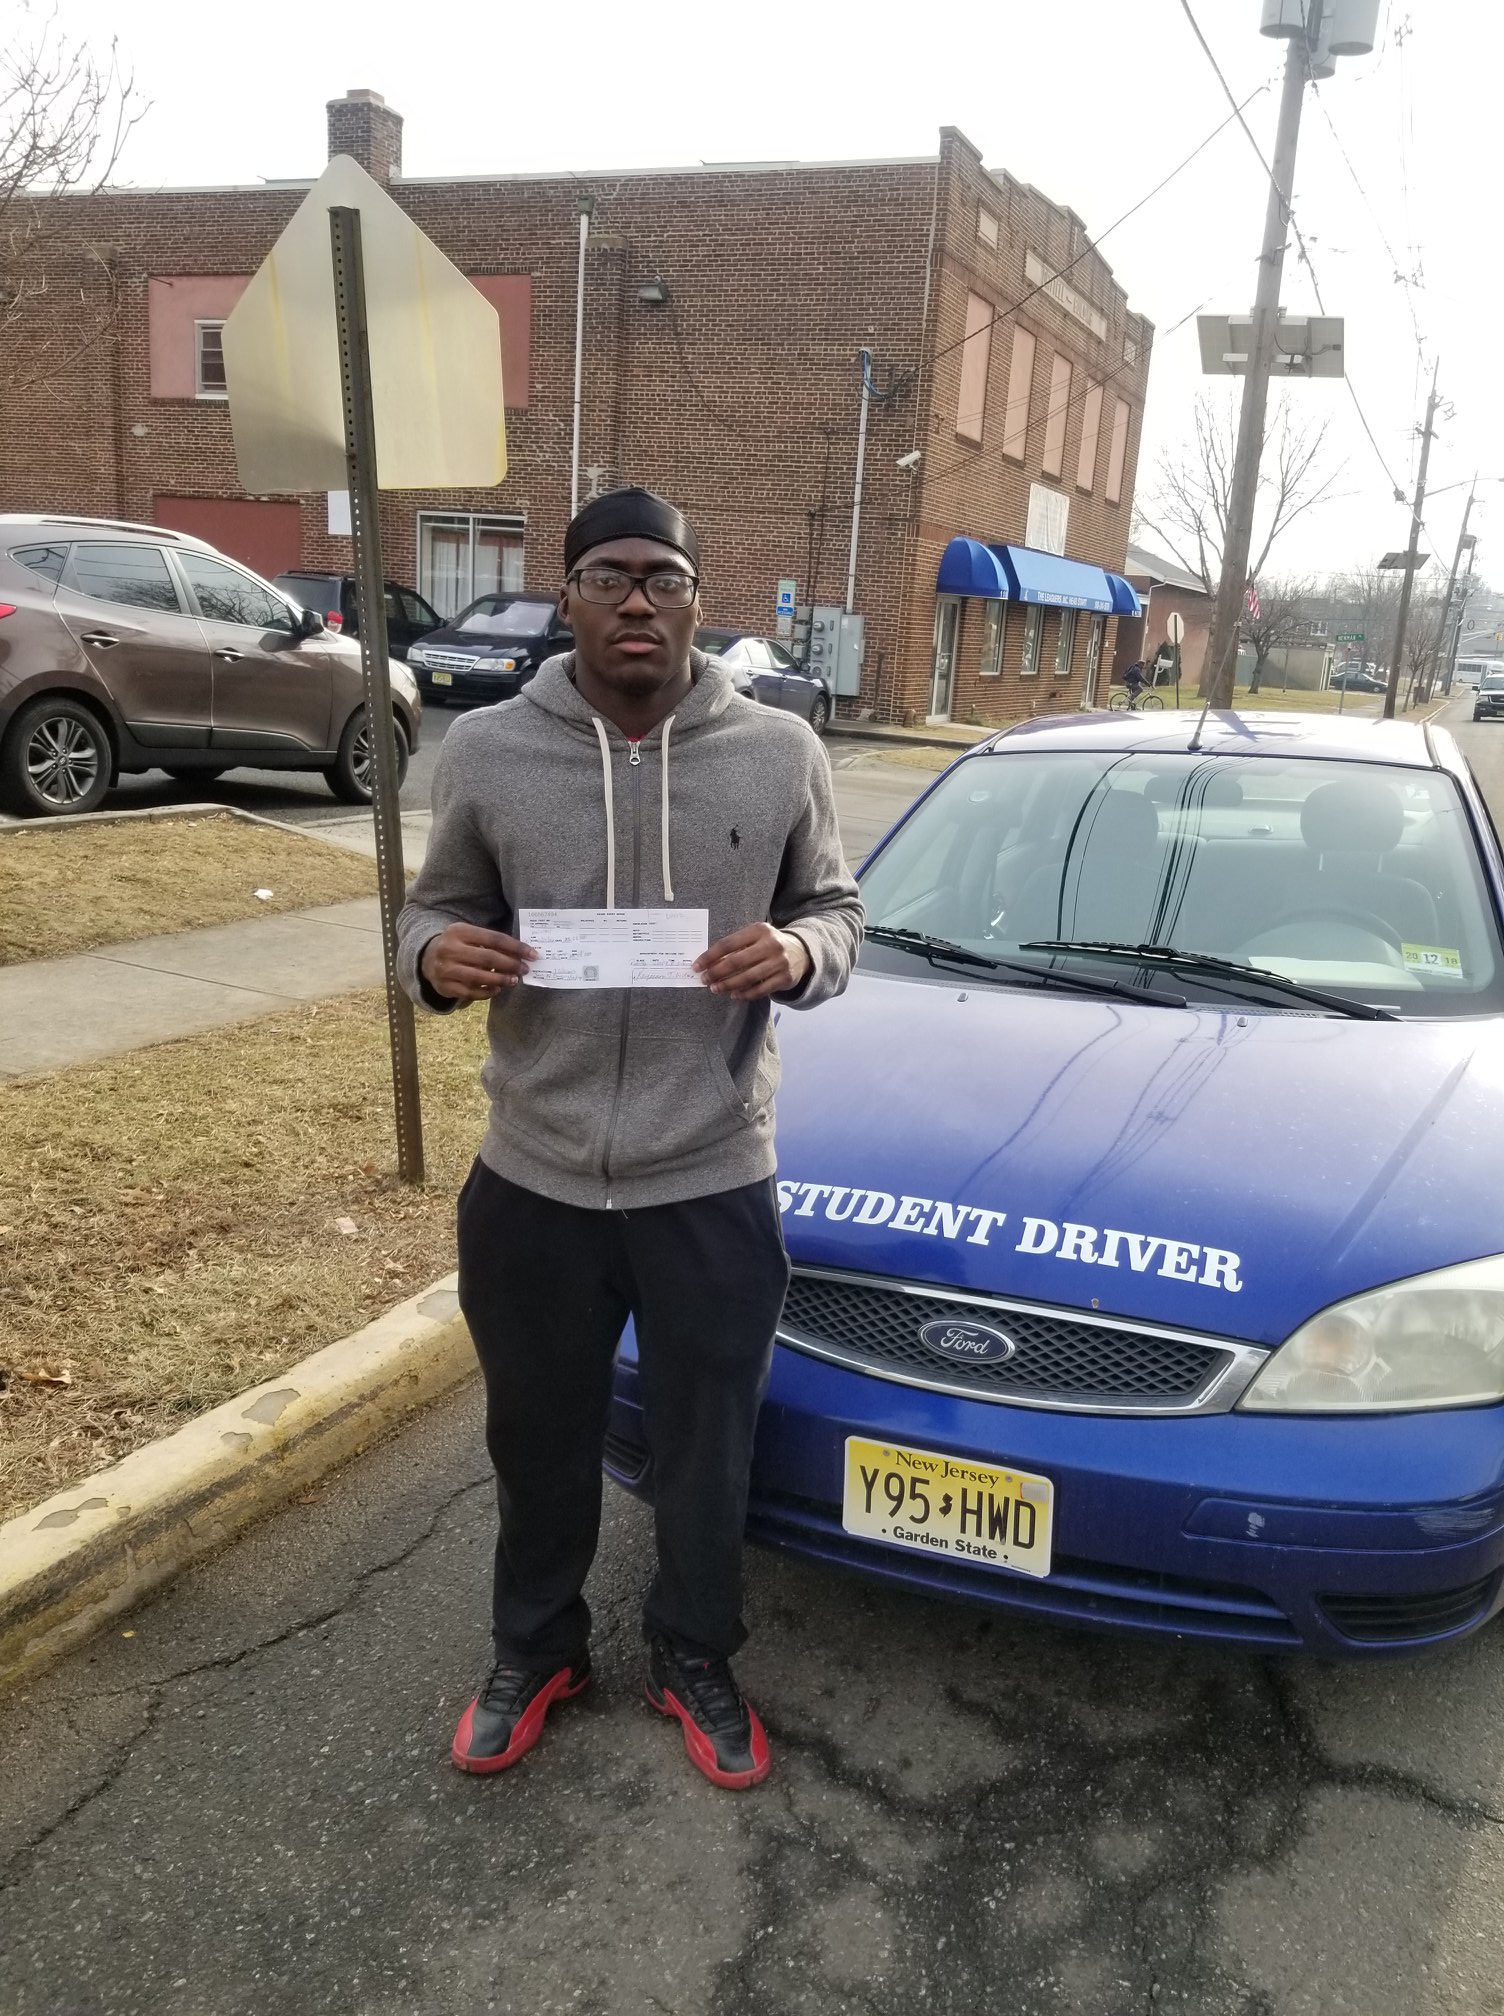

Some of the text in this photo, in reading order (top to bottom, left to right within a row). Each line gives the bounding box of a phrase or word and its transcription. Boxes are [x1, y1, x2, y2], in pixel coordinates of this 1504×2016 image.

[1406, 951, 1418, 960] 20
[1423, 953, 1439, 965] 12
[776, 1179, 1243, 1293] STUDENT DRIVER
[940, 1326, 991, 1356] Ford
[895, 1450, 1000, 1489] New Jersey
[859, 1465, 1036, 1550] Y95 HWD
[892, 1525, 998, 1560] Garden State
